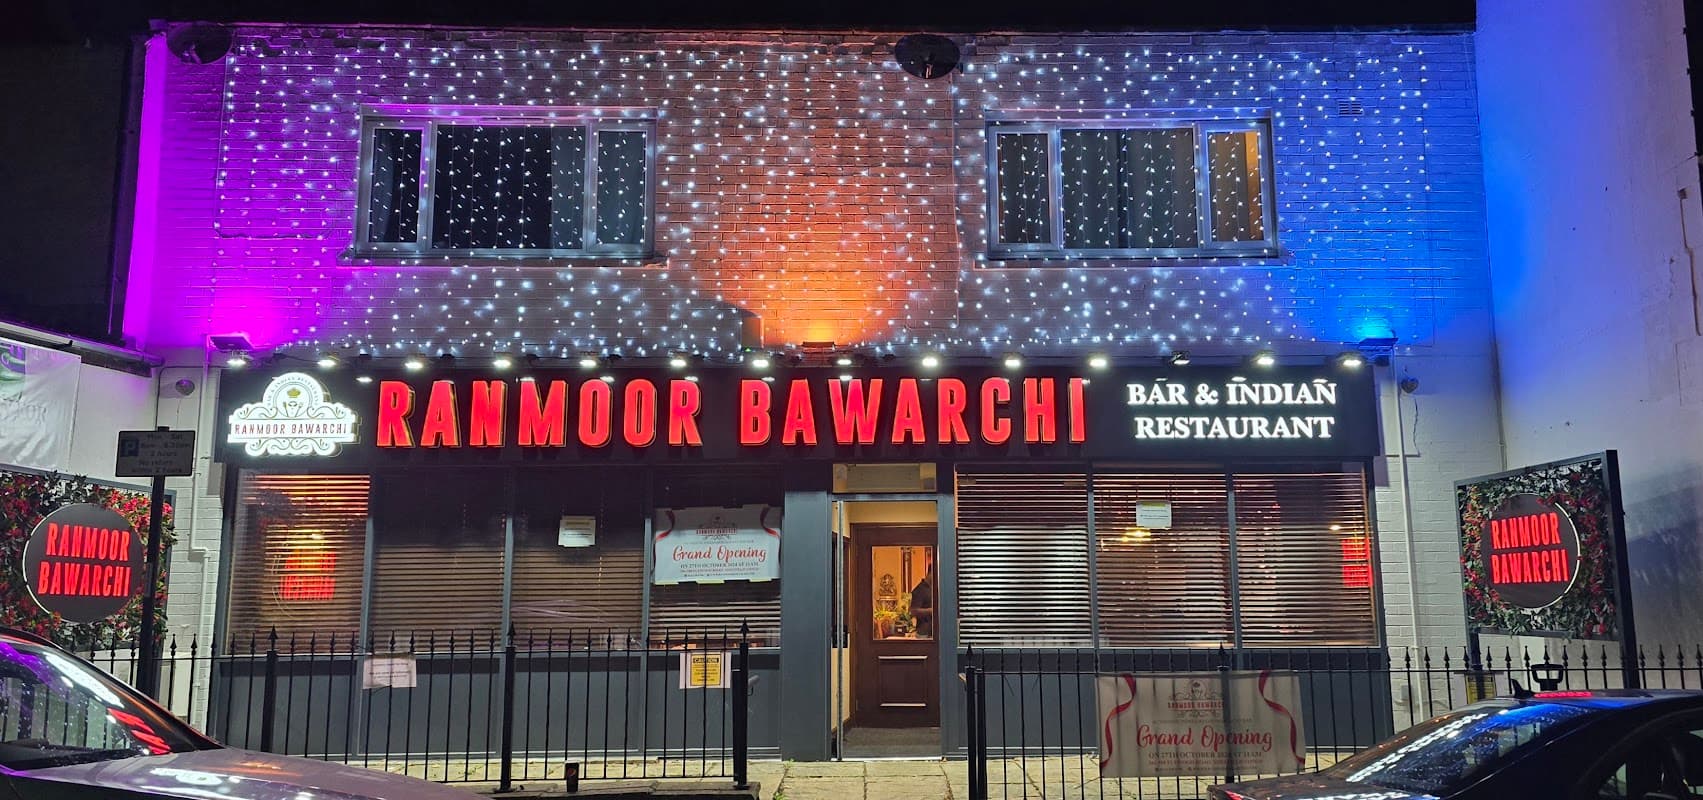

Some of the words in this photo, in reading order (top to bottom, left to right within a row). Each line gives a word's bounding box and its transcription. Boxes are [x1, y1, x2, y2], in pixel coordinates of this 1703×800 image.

[1127, 382, 1189, 406] BAR
[1194, 382, 1219, 406] &
[1225, 382, 1338, 406] INDIAN
[377, 380, 704, 447] RANMOOR
[740, 377, 1086, 446] BAWARCHI
[1133, 416, 1336, 439] RESTAURANT
[234, 423, 286, 435] RANMOOR
[291, 423, 347, 435] BAWARCHI
[46, 522, 131, 562] RANMOOR
[1491, 512, 1561, 550] RANMOOR
[673, 545, 712, 562] Grand
[716, 545, 767, 563] Opening
[1491, 549, 1570, 584] BAWARCHI
[38, 561, 132, 597] BAWARCHI
[1136, 724, 1193, 748] Grand
[1201, 725, 1273, 752] Opening
